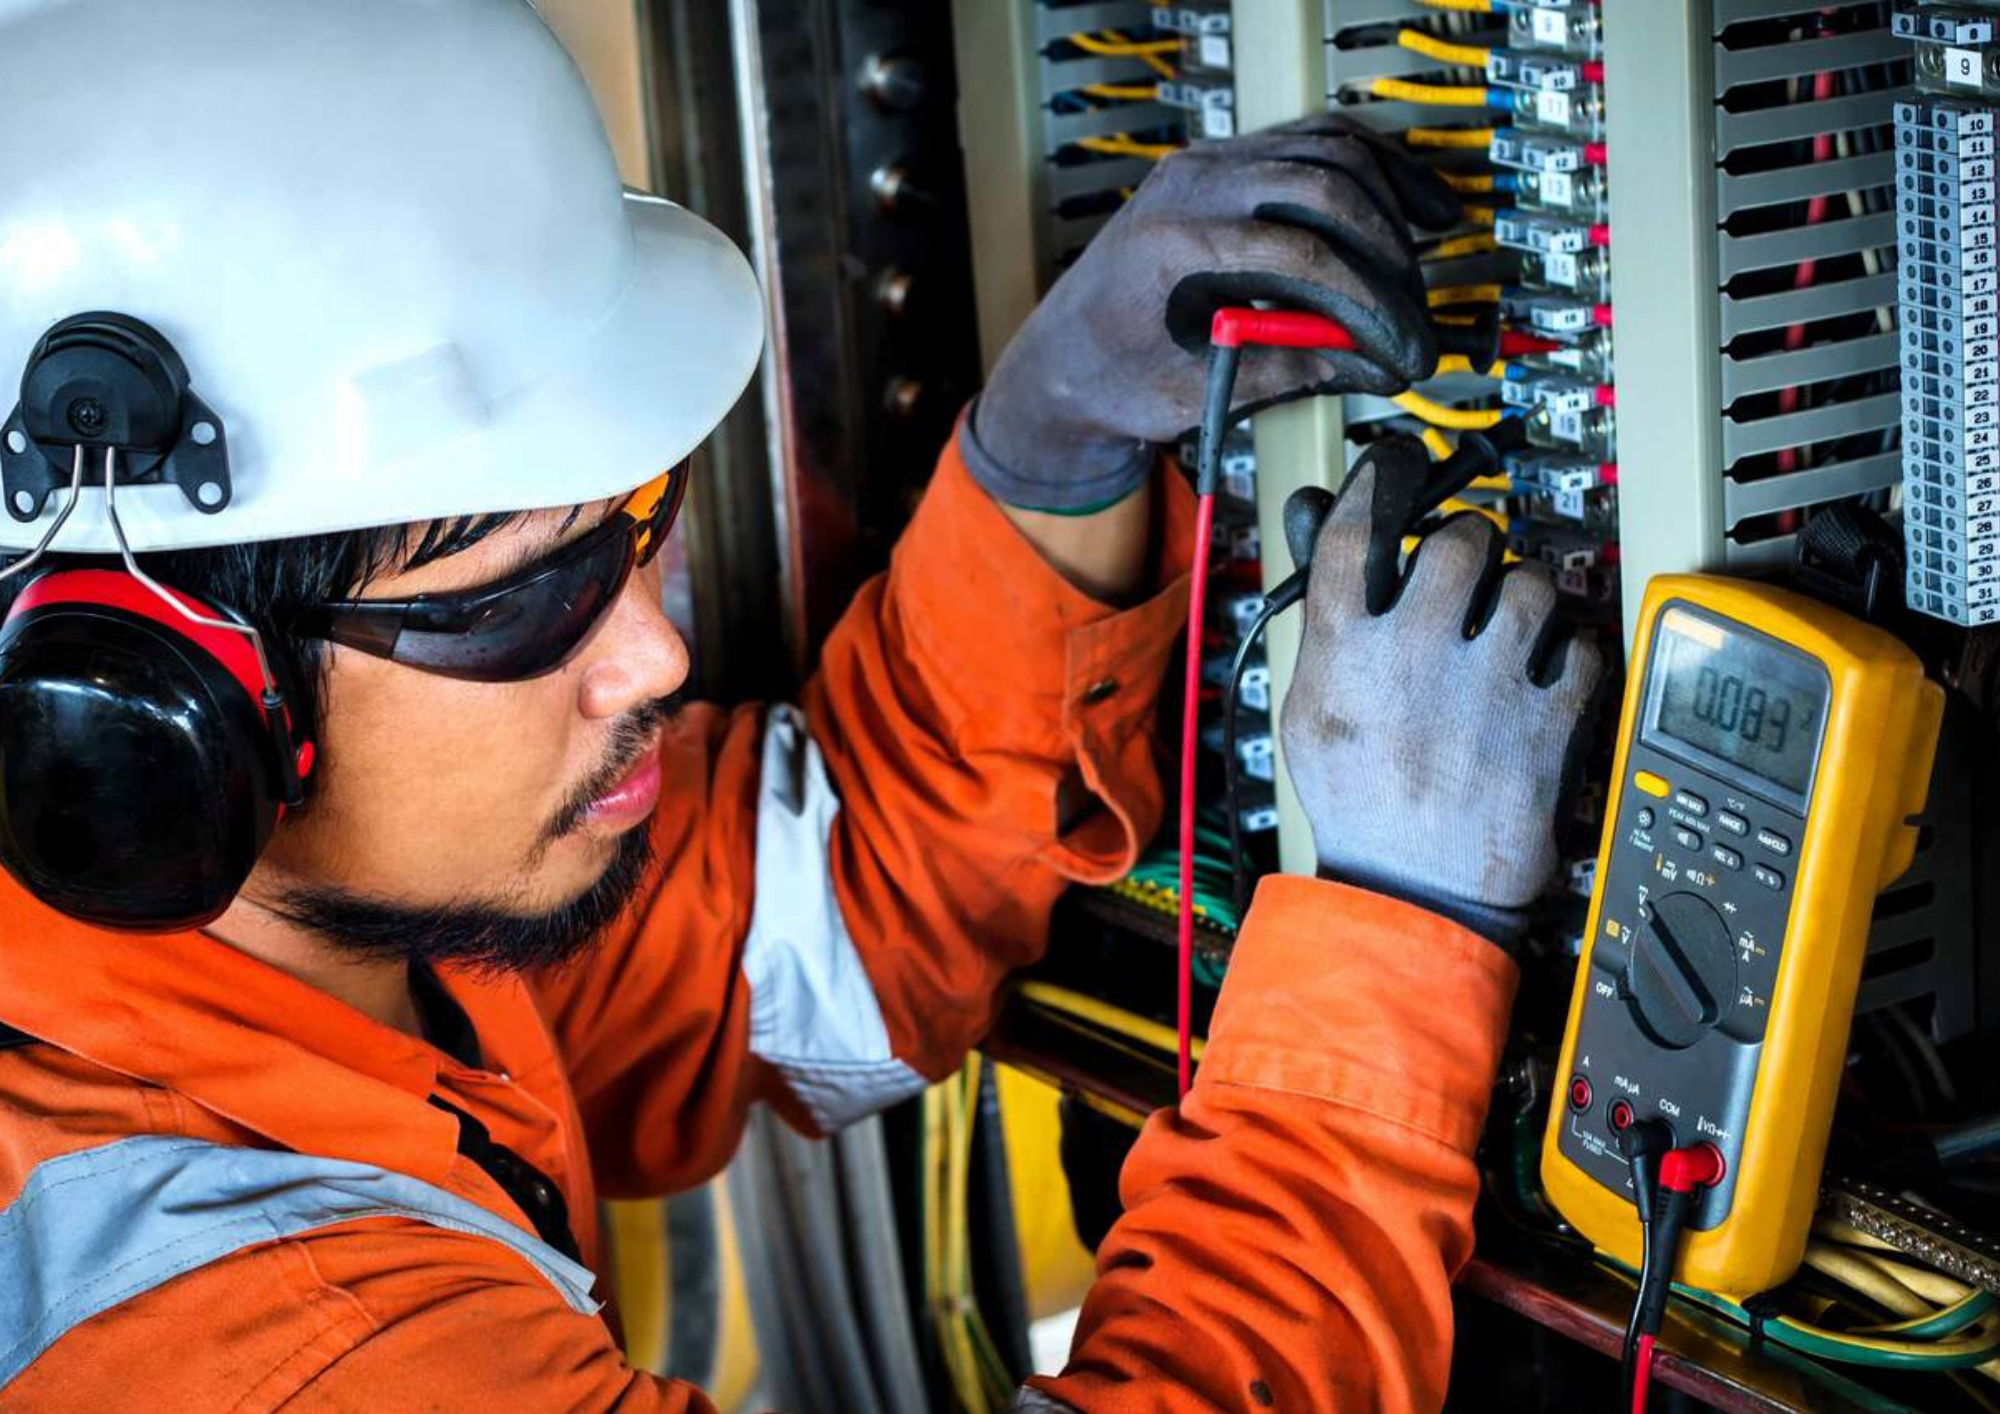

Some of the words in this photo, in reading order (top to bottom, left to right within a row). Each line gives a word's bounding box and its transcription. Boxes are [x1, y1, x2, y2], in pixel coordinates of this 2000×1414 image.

[1961, 58, 1970, 75] 9
[1970, 119, 1984, 131] 10
[1971, 142, 1985, 152] 11
[1971, 165, 1985, 176] 12
[1971, 188, 1986, 199] 13
[1972, 211, 1987, 222] 14
[1974, 233, 1988, 245] 15
[1974, 252, 1988, 264] 16
[1973, 278, 1987, 290] 17
[1974, 300, 1988, 311] 18
[1974, 323, 1988, 335] 19
[1972, 345, 1988, 356] 20
[1974, 367, 1988, 379] 21
[1974, 389, 1989, 401] 22
[1974, 412, 1990, 423] 23
[1973, 433, 1988, 444] 24
[1975, 455, 1990, 466] 25
[1976, 478, 1992, 489] 26
[1977, 501, 1992, 512] 27
[1977, 522, 1992, 533] 28
[1979, 543, 1994, 555] 29
[1978, 565, 1993, 576] 30
[1978, 588, 1993, 599] 31
[1979, 609, 1995, 621] 32
[1595, 982, 1613, 998] OFF
[1582, 1055, 1590, 1068] A
[1659, 1098, 1681, 1117] COM
